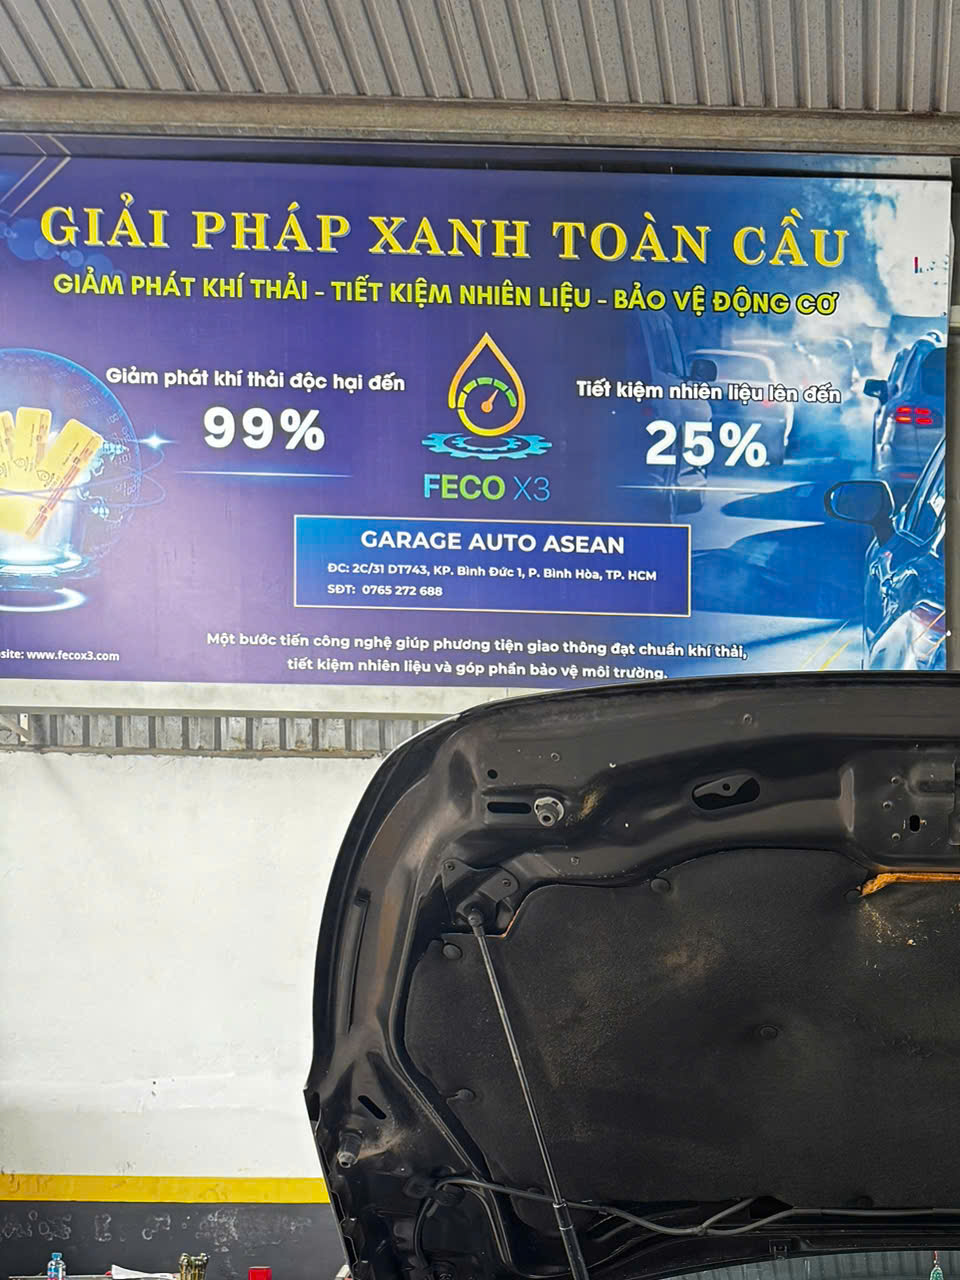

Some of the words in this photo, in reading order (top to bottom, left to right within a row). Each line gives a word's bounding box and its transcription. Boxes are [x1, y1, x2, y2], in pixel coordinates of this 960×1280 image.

[41, 192, 170, 249] GIẢI
[192, 201, 352, 255] PHÁP
[368, 216, 532, 259] XANH
[552, 211, 711, 264] TOÀN
[733, 208, 849, 267] CẦU
[53, 266, 124, 295] GIẢM
[131, 270, 195, 297] PHÁT
[203, 272, 245, 299] KHÍ
[250, 271, 308, 300] THẢI
[331, 274, 383, 302] TIẾT
[390, 277, 452, 308] KIỆM
[460, 279, 531, 306] NHIÊN
[539, 281, 591, 312] LIỆU
[613, 283, 666, 311] BẢO
[673, 285, 706, 316] VỆ
[713, 287, 789, 317] ĐỘNG
[796, 292, 839, 315] CƠ
[106, 366, 158, 385] Giảm
[164, 368, 208, 390] phát
[214, 369, 244, 387] khí
[248, 370, 284, 389] thải
[289, 371, 327, 392] độc
[333, 373, 363, 394] hại
[369, 372, 405, 391] đến
[576, 377, 611, 398] Tiết
[616, 381, 663, 403] kiệm
[669, 382, 722, 400] nhiên
[728, 383, 763, 405] liệu
[768, 384, 798, 402] lên
[803, 382, 841, 403] đến
[203, 406, 326, 451] 99%
[645, 420, 768, 468] 25%
[423, 474, 505, 500] FECO
[513, 476, 551, 501] X3
[360, 530, 462, 550] GARAGE
[468, 533, 537, 552] AUTO
[543, 535, 625, 554] ASEAN
[328, 563, 350, 573] ĐC:
[352, 563, 384, 575] 2C/31
[388, 564, 430, 577] DT743,
[433, 565, 454, 576] KP.
[457, 565, 486, 577] Bình
[489, 566, 514, 577] Đức
[517, 568, 525, 579] 1,
[528, 568, 540, 578] P.
[544, 568, 572, 579] Bình
[576, 569, 603, 581] Hòa,
[606, 570, 625, 580] TP.
[628, 571, 657, 581] HCM
[327, 584, 356, 595] SĐT:
[362, 585, 392, 595] 0765
[395, 585, 417, 596] 272
[419, 586, 443, 597] 688
[26, 650, 120, 661] www.fecox3.com
[207, 633, 235, 648] Một
[239, 633, 276, 646] bước
[280, 633, 309, 646] tiến
[313, 635, 350, 650] công
[354, 636, 392, 650] nghệ
[395, 637, 429, 652] giúp
[433, 638, 490, 653] phương
[494, 639, 523, 654] tiện
[527, 640, 559, 655] giao
[563, 640, 607, 656] thông
[611, 642, 635, 657] đạt
[639, 643, 683, 657] chuẩn
[688, 643, 711, 657] khí
[714, 644, 747, 660] thải,
[287, 657, 314, 670] tiết
[317, 658, 354, 673] kiệm
[358, 658, 400, 672] nhiên
[404, 659, 431, 674] liệu
[435, 661, 452, 673] và
[456, 662, 485, 677] góp
[488, 662, 525, 677] phần
[530, 663, 557, 676] bảo
[560, 664, 578, 679] vệ
[582, 665, 609, 678] môi
[613, 666, 668, 679] trường.
